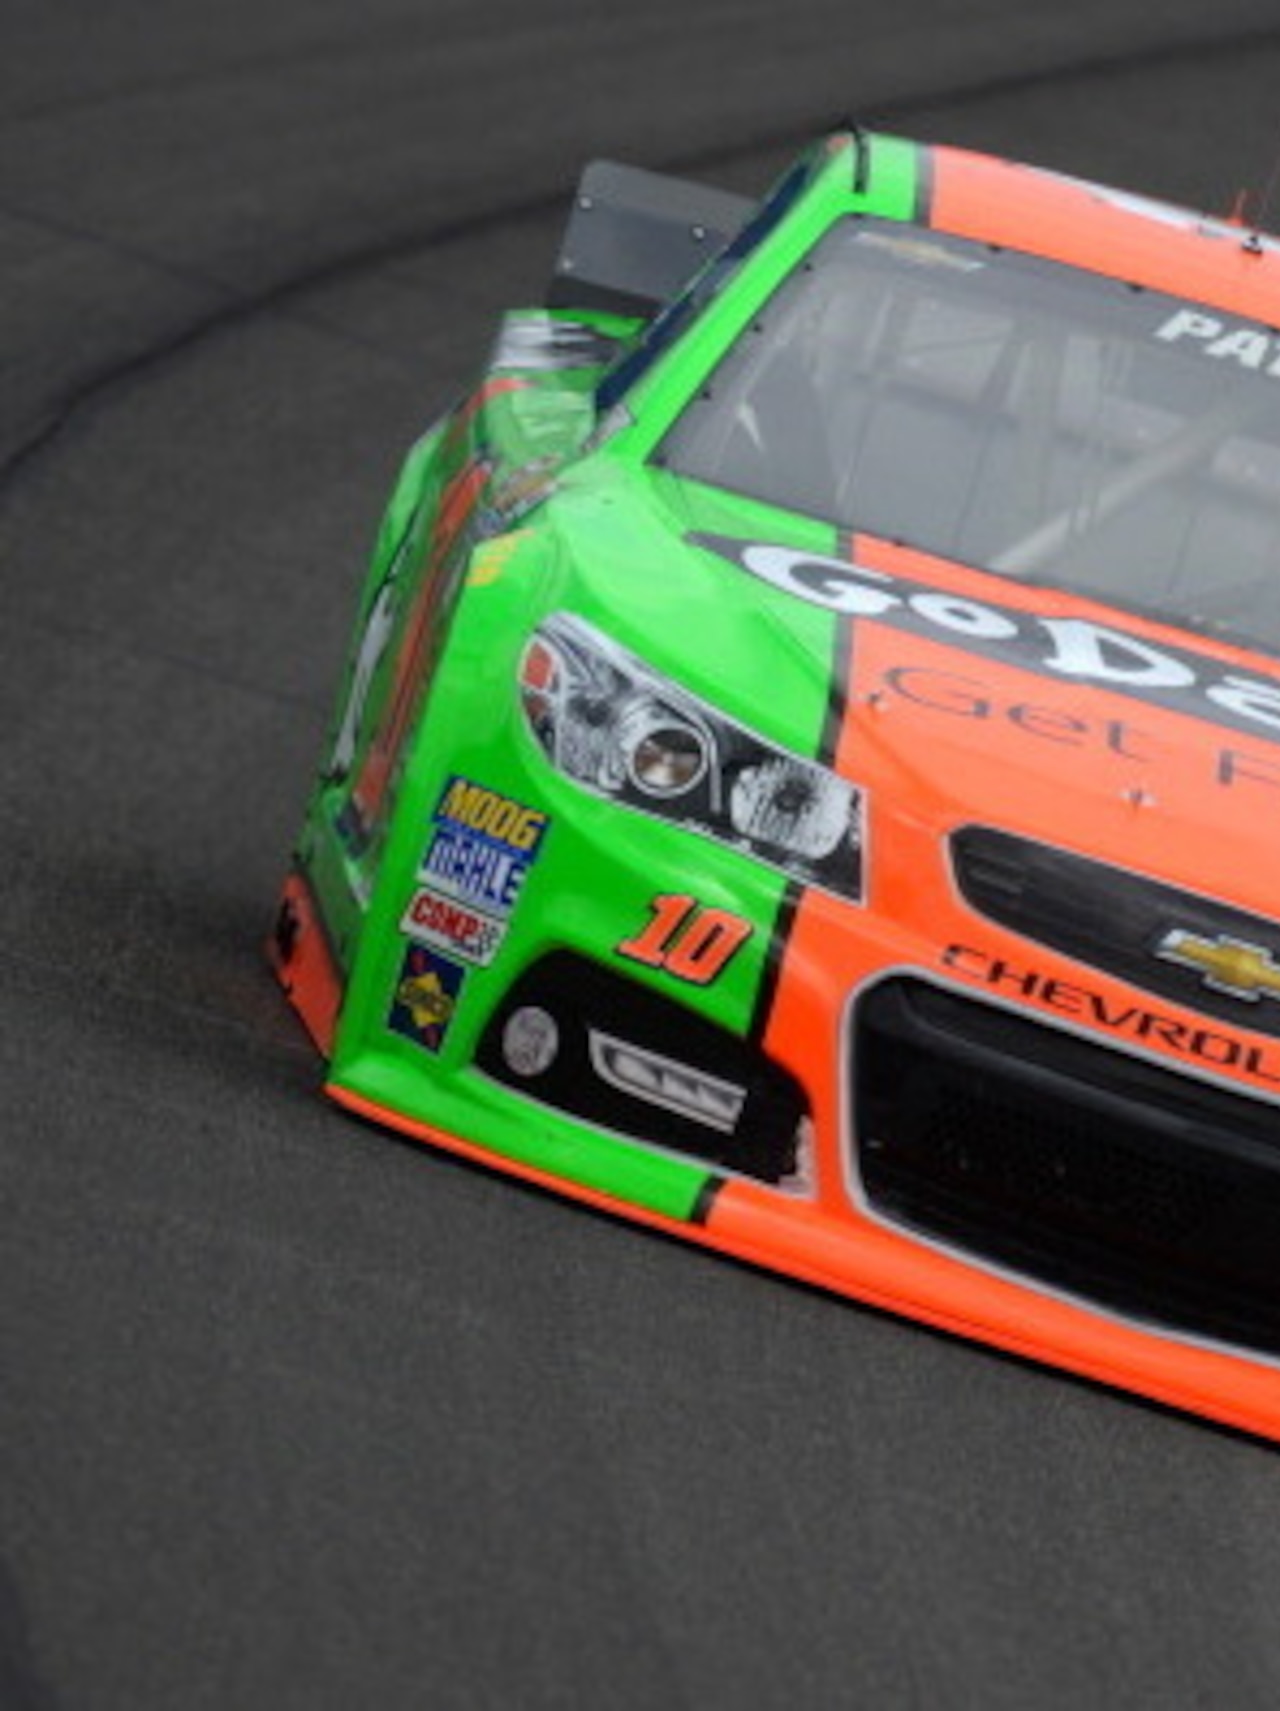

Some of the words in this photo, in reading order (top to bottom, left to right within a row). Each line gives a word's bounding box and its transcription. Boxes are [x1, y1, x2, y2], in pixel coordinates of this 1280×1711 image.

[885, 667, 1153, 762] Get
[438, 779, 545, 849] MOOG
[616, 893, 754, 985] 10
